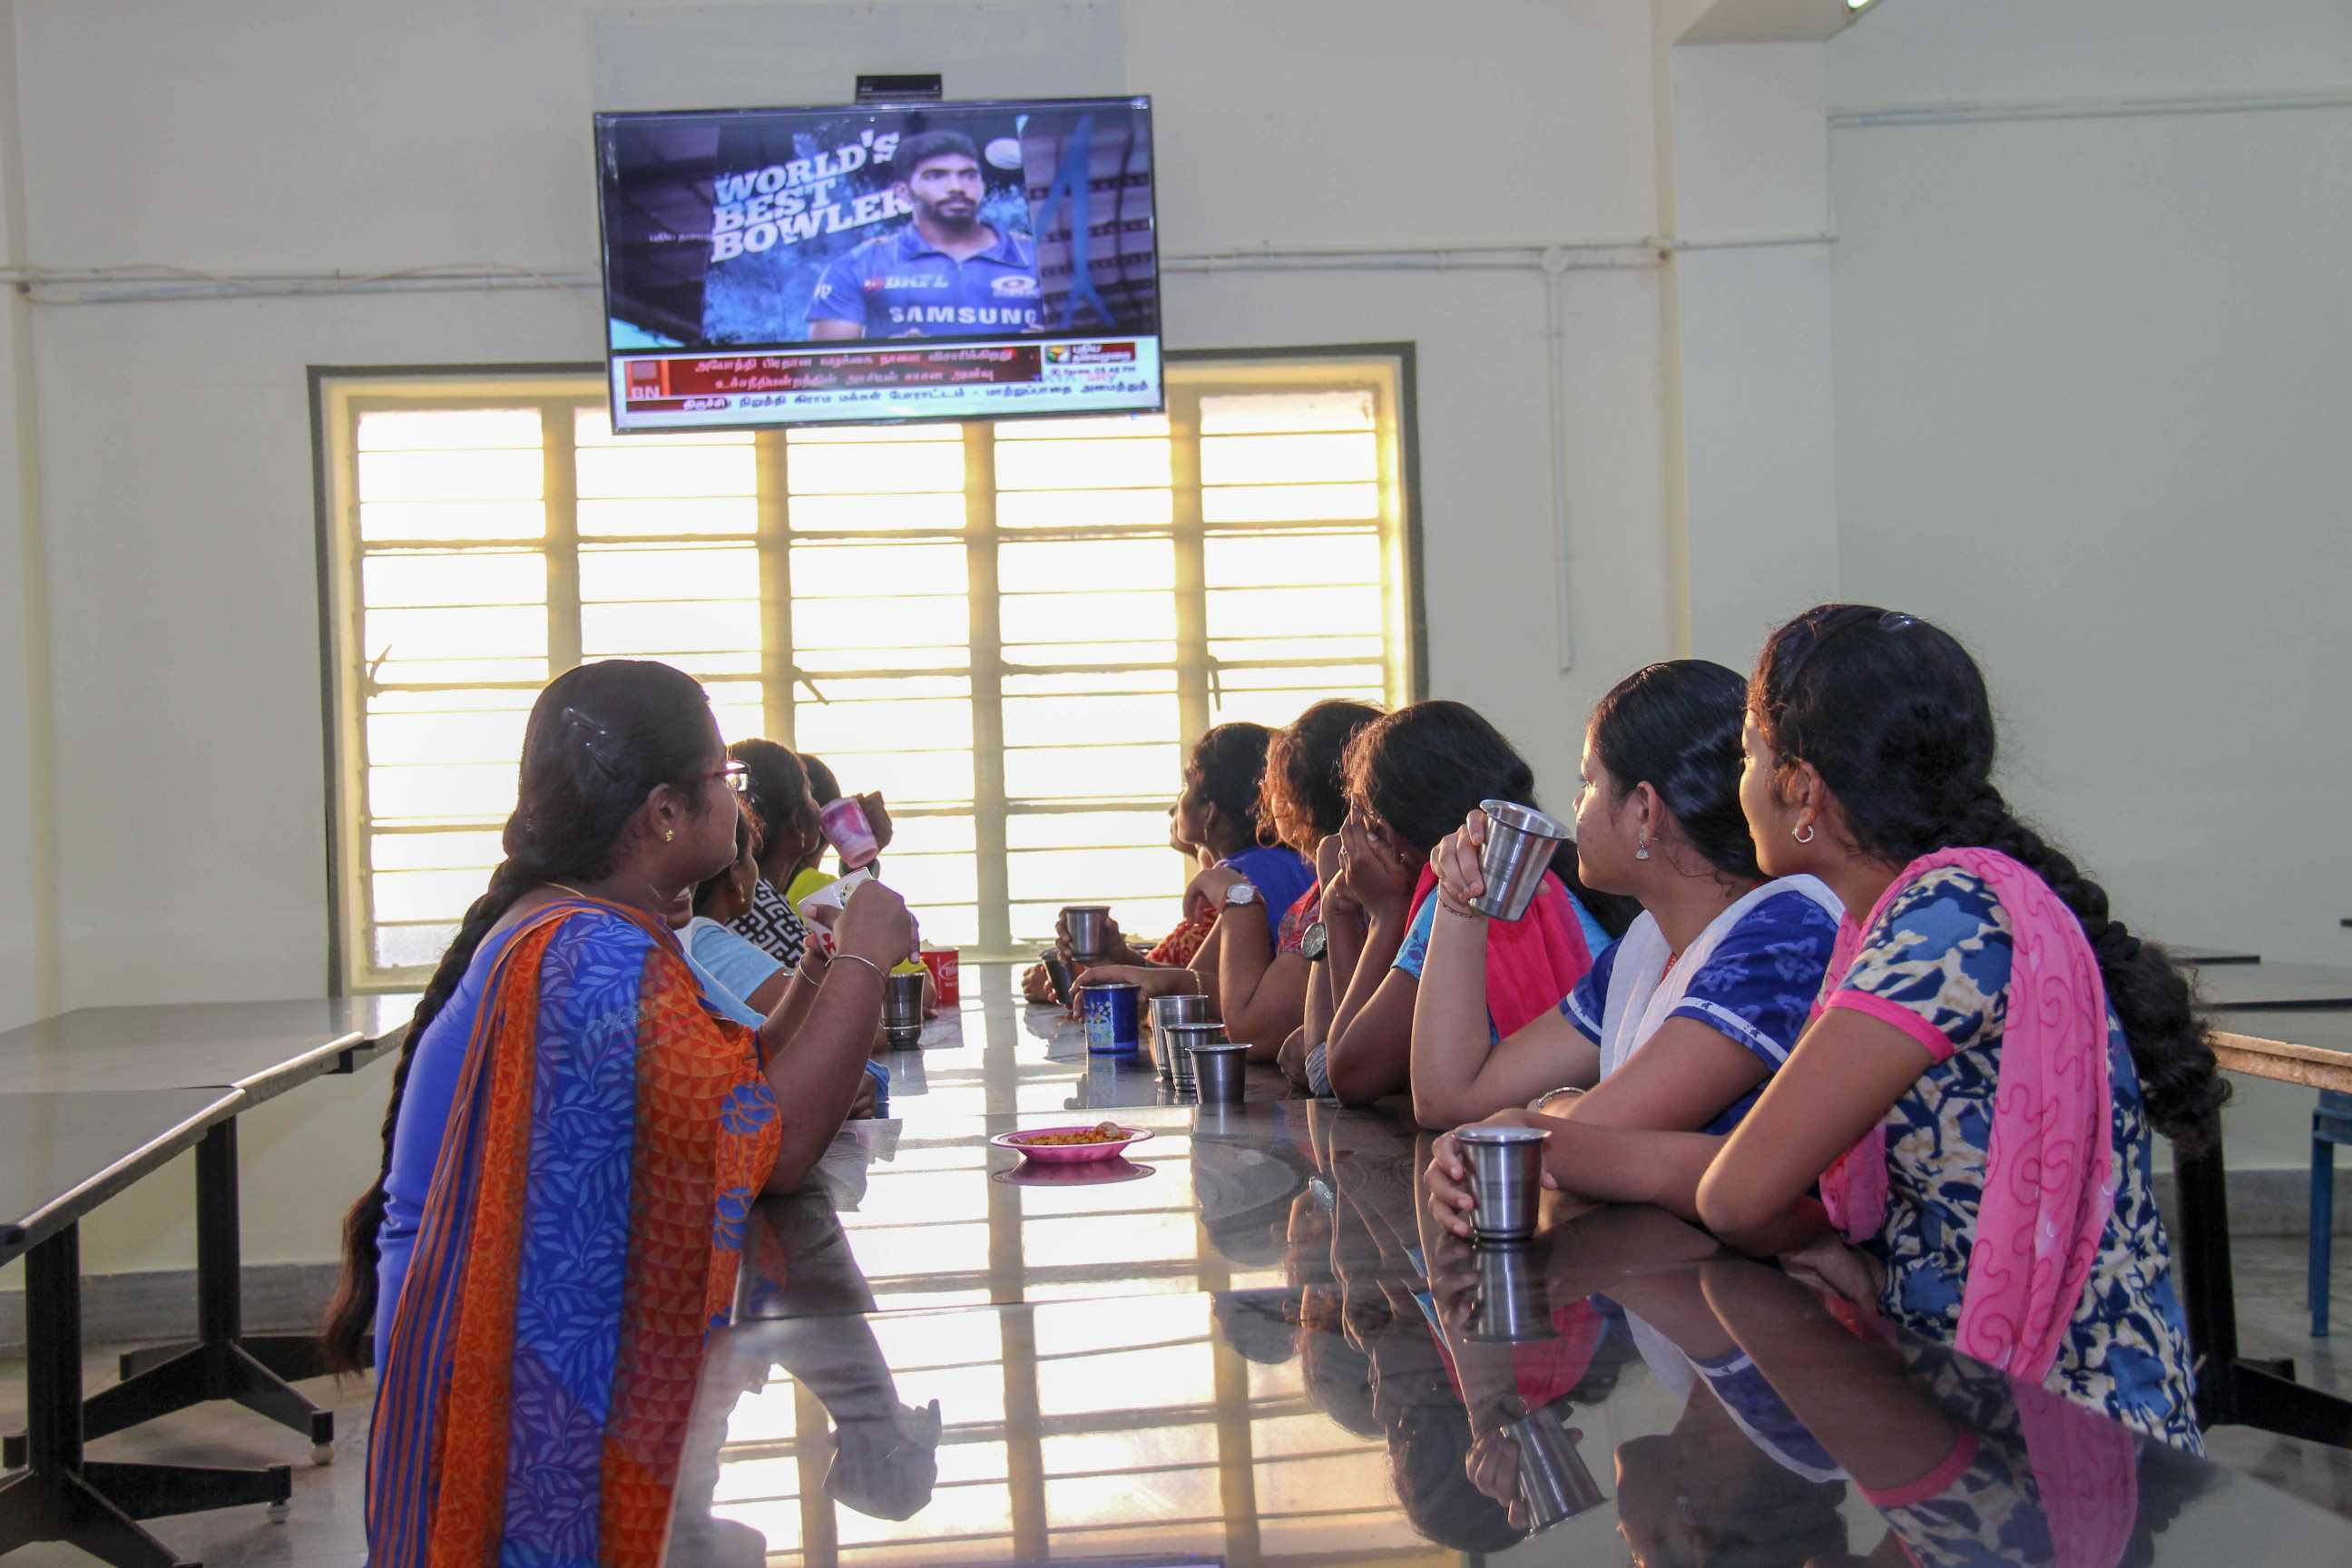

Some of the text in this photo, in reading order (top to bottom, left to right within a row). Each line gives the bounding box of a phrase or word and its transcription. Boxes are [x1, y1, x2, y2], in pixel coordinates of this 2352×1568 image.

[714, 129, 899, 204] WORLD'S
[712, 177, 837, 235] BEST
[632, 385, 660, 400] BN
